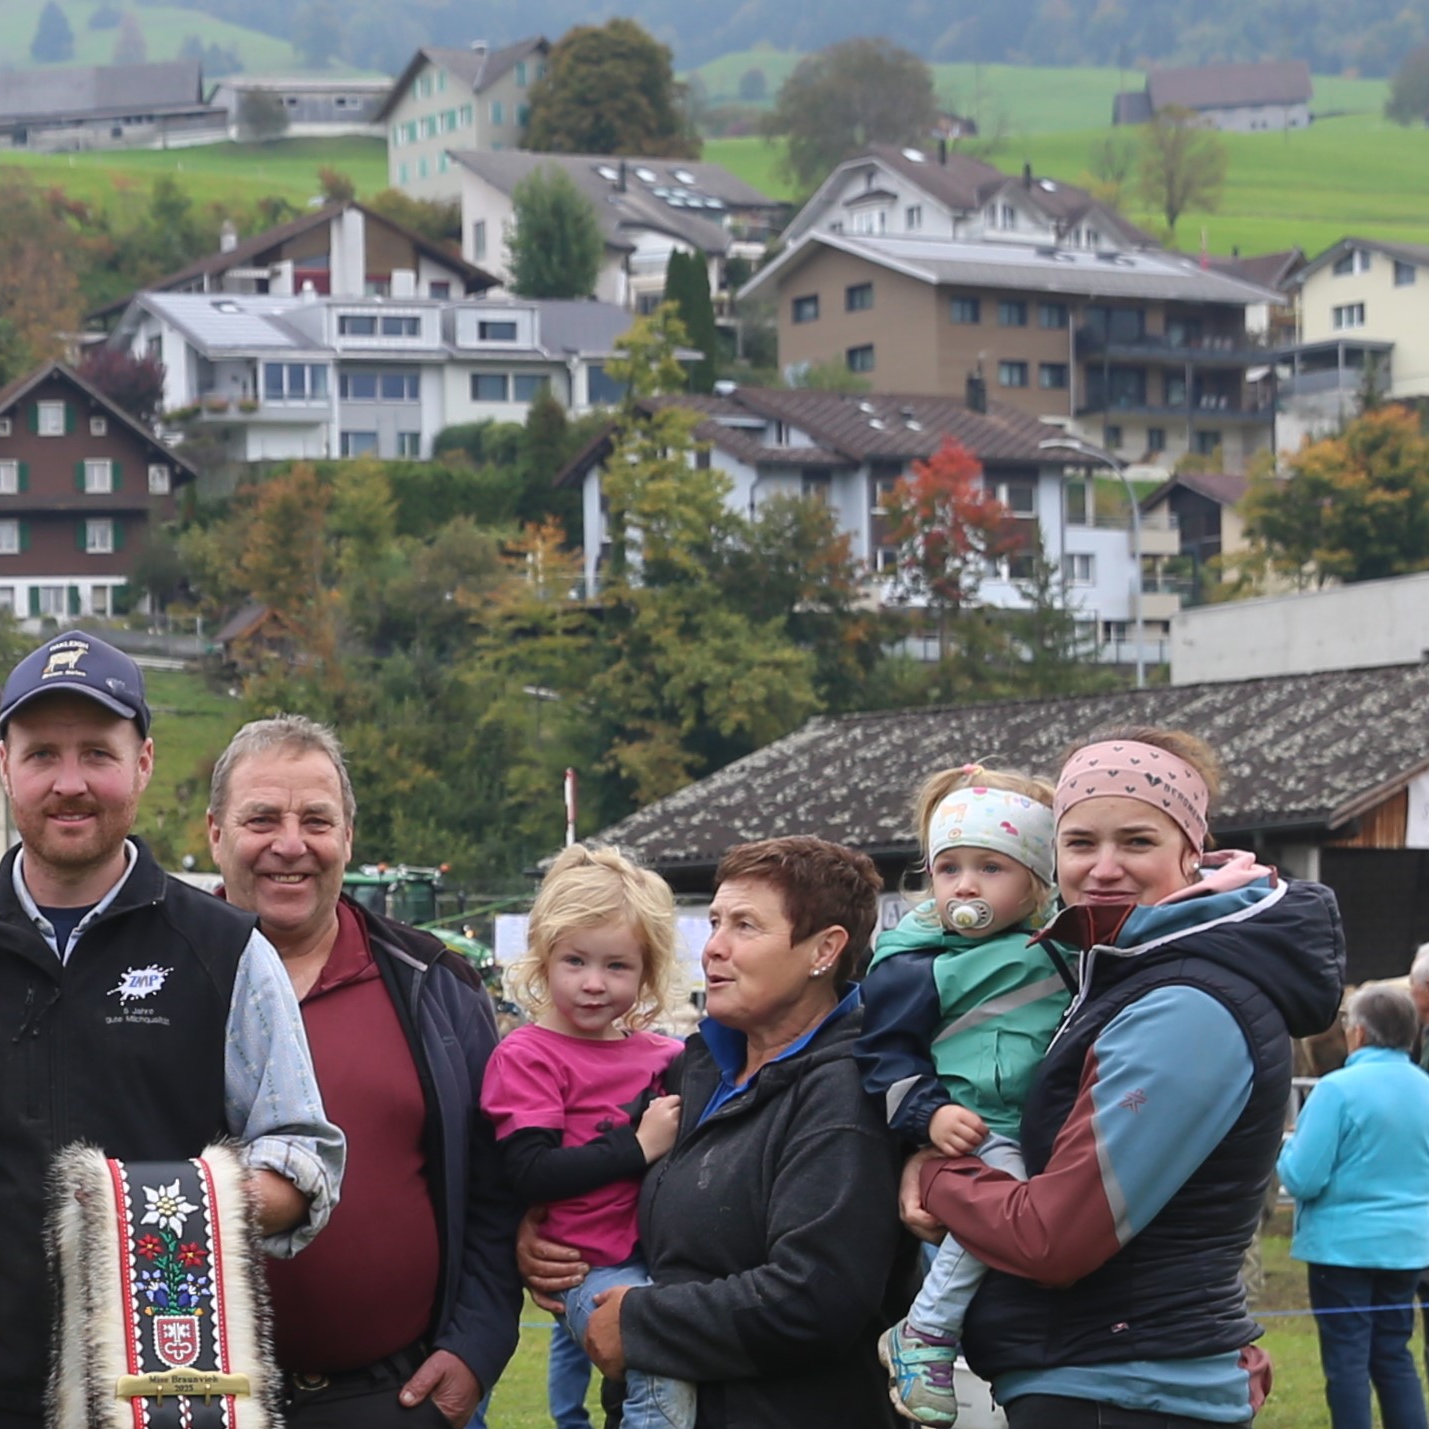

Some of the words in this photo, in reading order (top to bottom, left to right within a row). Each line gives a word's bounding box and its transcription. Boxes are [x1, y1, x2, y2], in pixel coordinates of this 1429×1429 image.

[148, 1375, 168, 1384] Miss
[171, 1375, 219, 1384] Braunvieh
[174, 1384, 194, 1392] 2025
